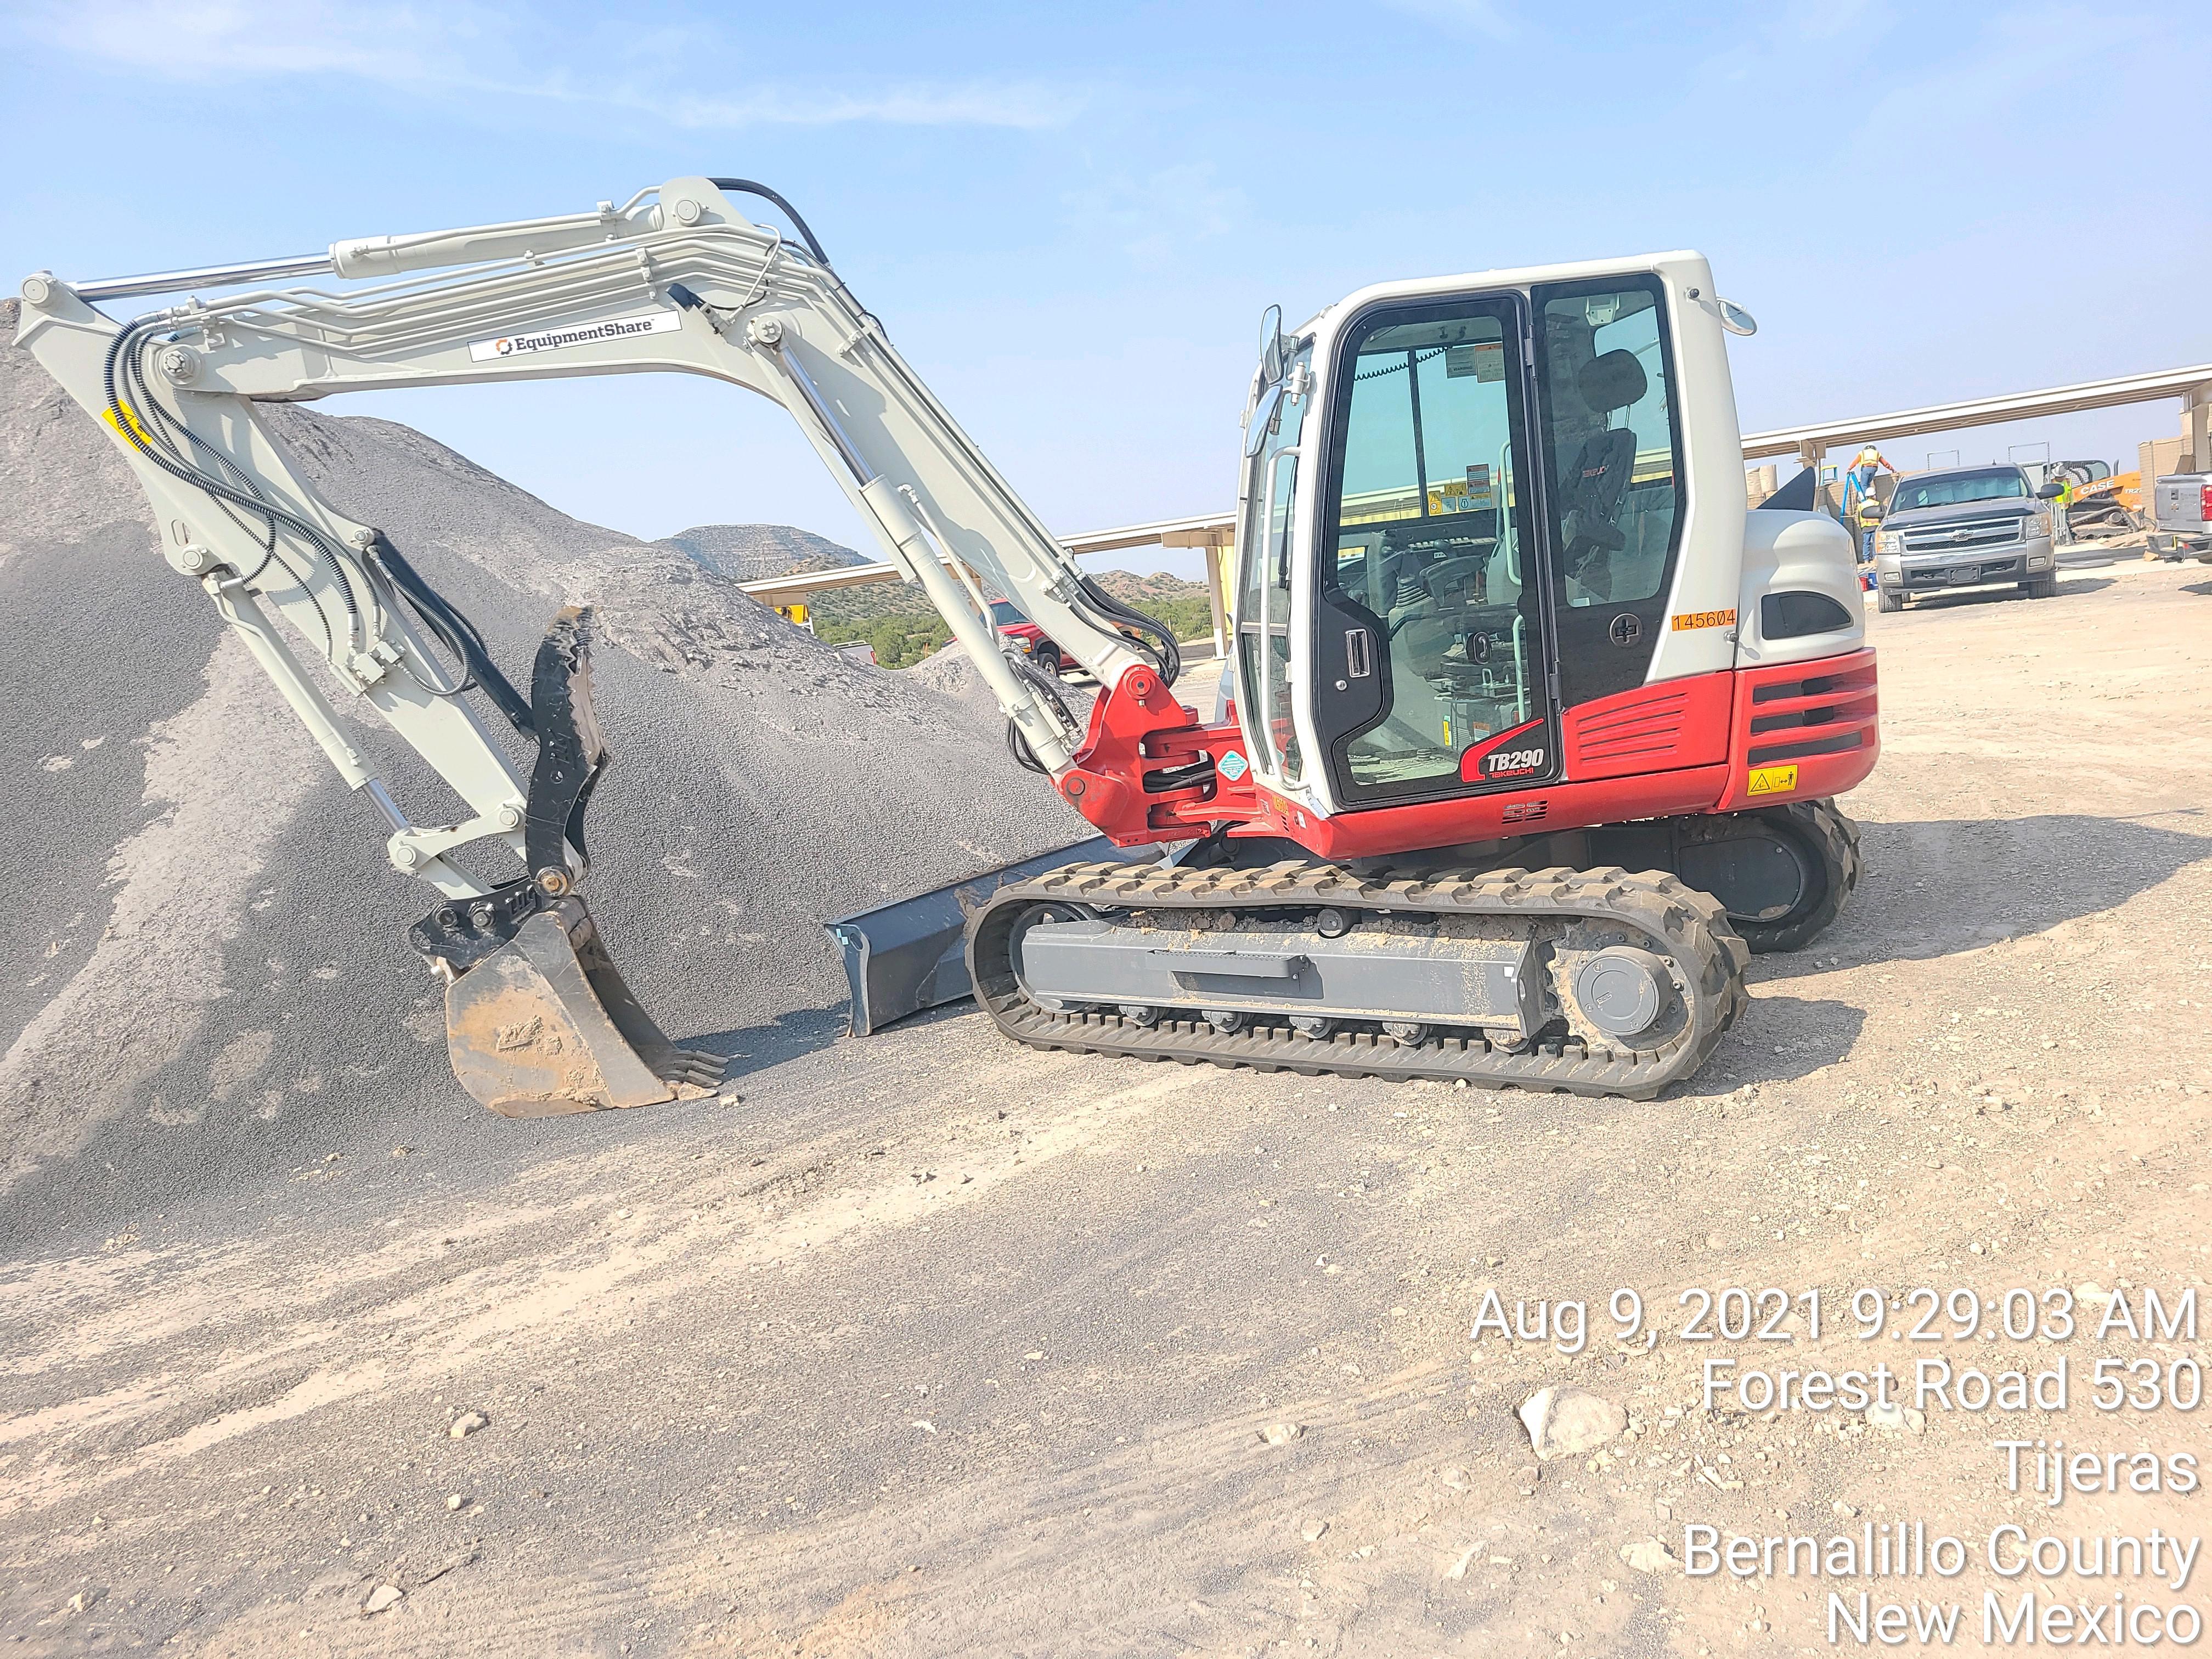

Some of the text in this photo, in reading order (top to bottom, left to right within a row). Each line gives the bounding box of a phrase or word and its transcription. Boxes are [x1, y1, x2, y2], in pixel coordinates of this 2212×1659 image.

[515, 320, 652, 351] EquipmentShare
[2080, 479, 2115, 495] CASE
[1674, 609, 1735, 630] 145604
[1488, 748, 1544, 772] TB290
[1489, 768, 1534, 778] TAKEUCHI
